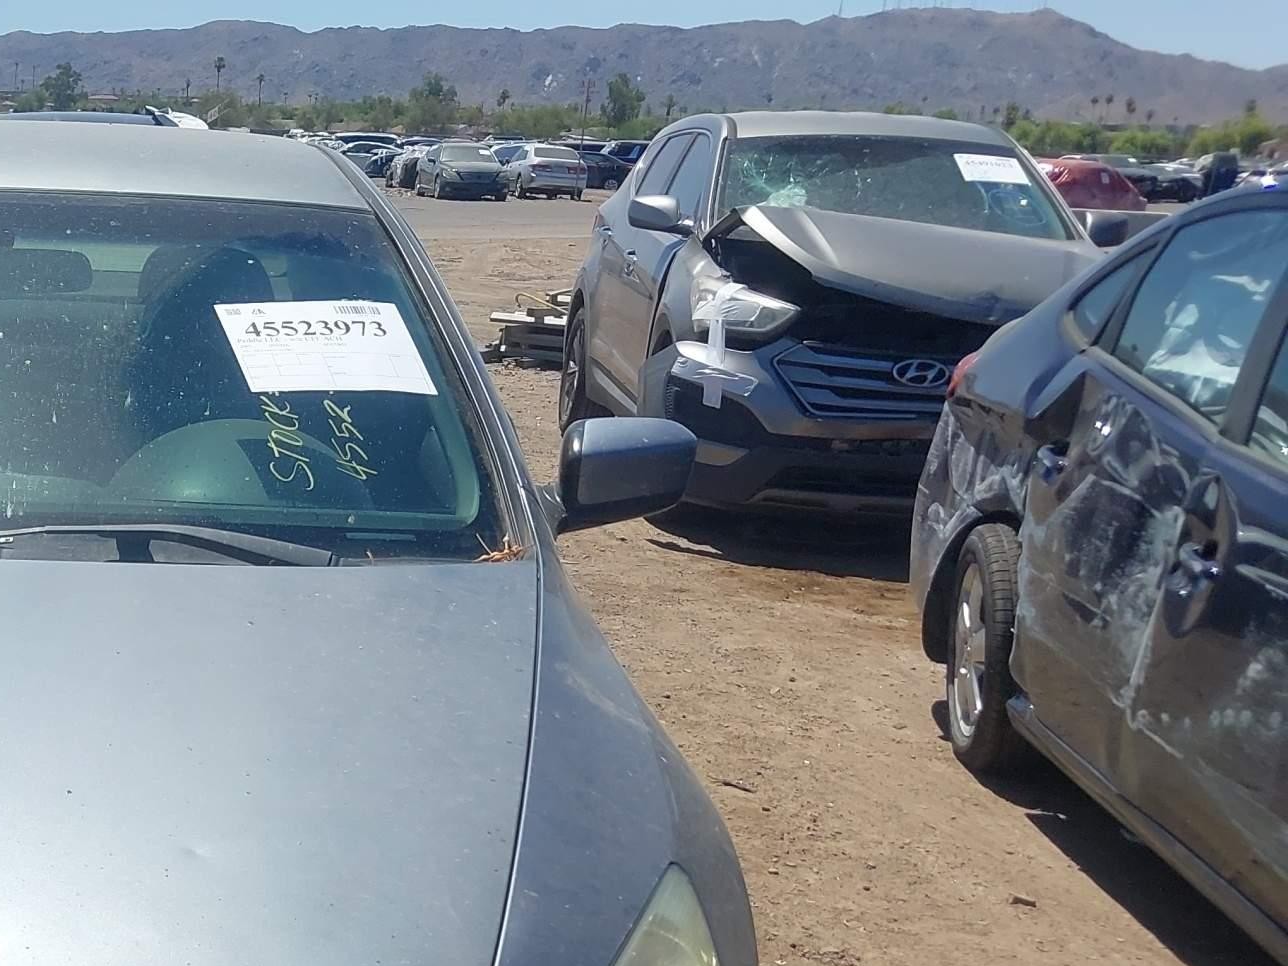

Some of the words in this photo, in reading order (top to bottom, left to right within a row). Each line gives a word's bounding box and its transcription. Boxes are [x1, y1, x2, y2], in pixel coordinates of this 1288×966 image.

[244, 319, 387, 337] 45523973
[259, 391, 314, 491] STOCK
[323, 391, 378, 480] 4552
